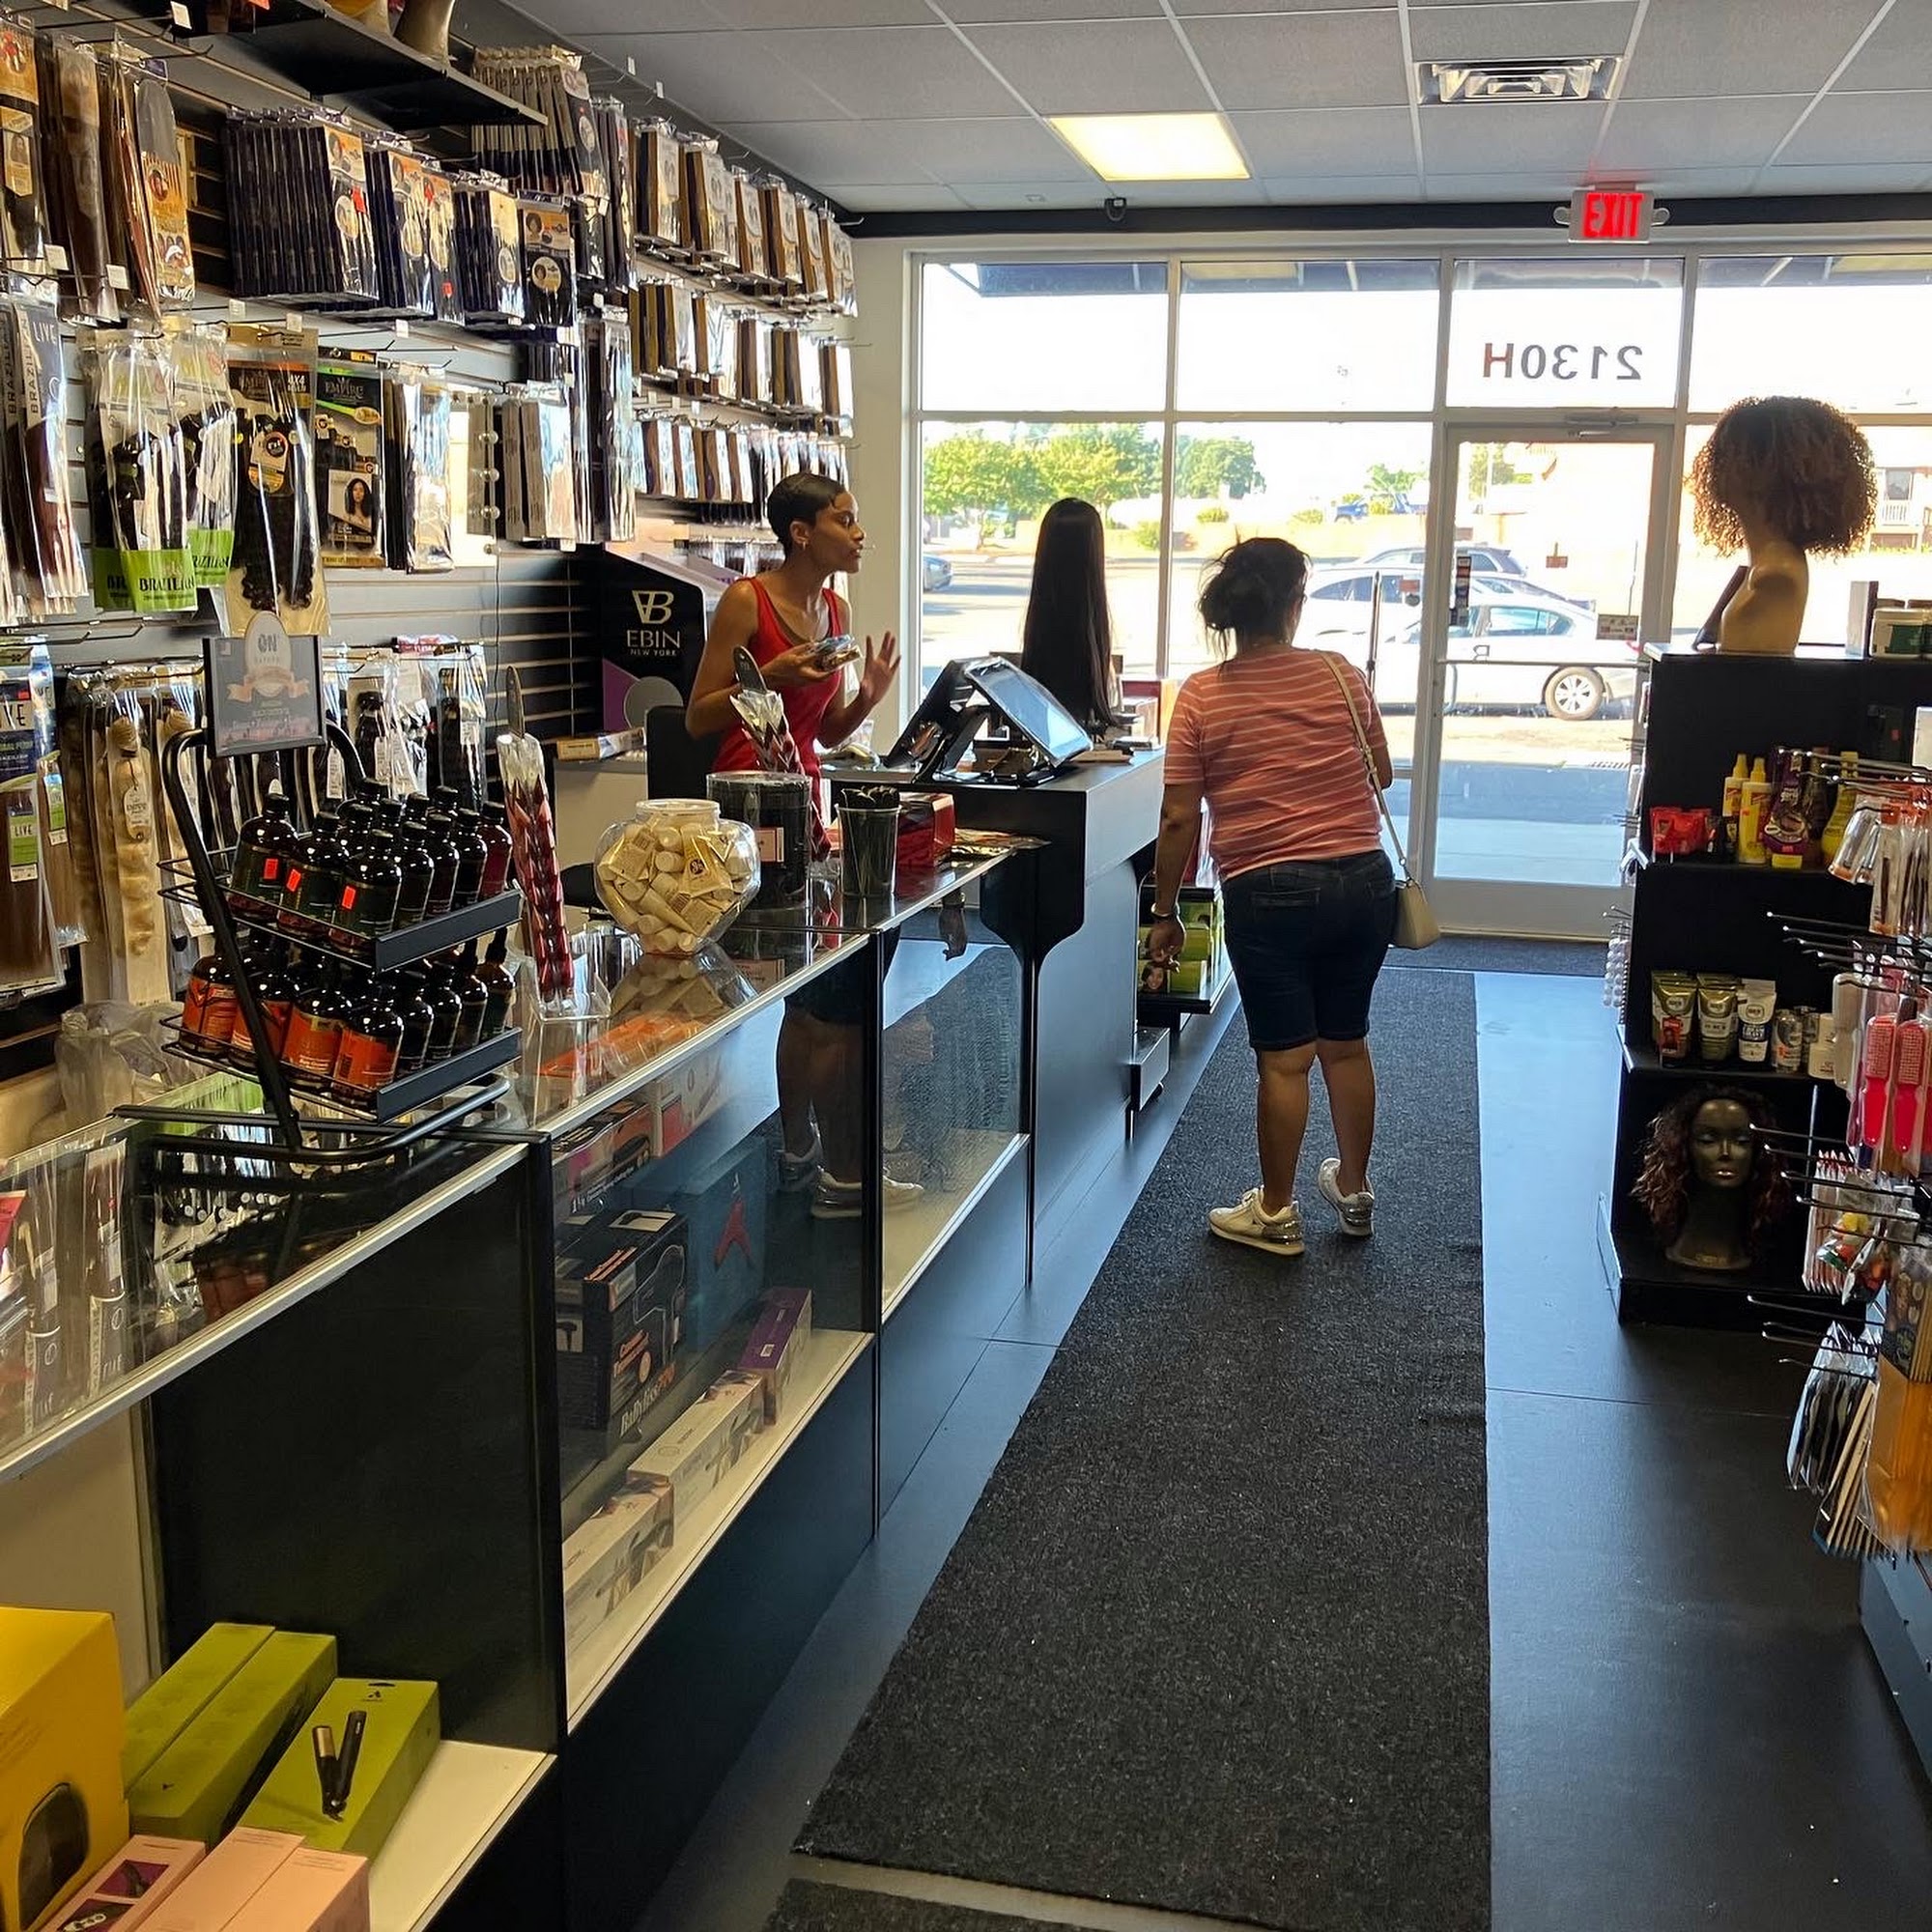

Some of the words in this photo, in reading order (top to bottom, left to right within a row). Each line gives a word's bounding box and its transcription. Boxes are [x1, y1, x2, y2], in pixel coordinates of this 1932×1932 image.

[1583, 192, 1644, 238] EXIT
[33, 321, 56, 345] LIVE
[626, 629, 680, 648] EBIN
[654, 648, 676, 657] YORK
[0, 703, 26, 727] VE
[14, 824, 34, 838] LIVE
